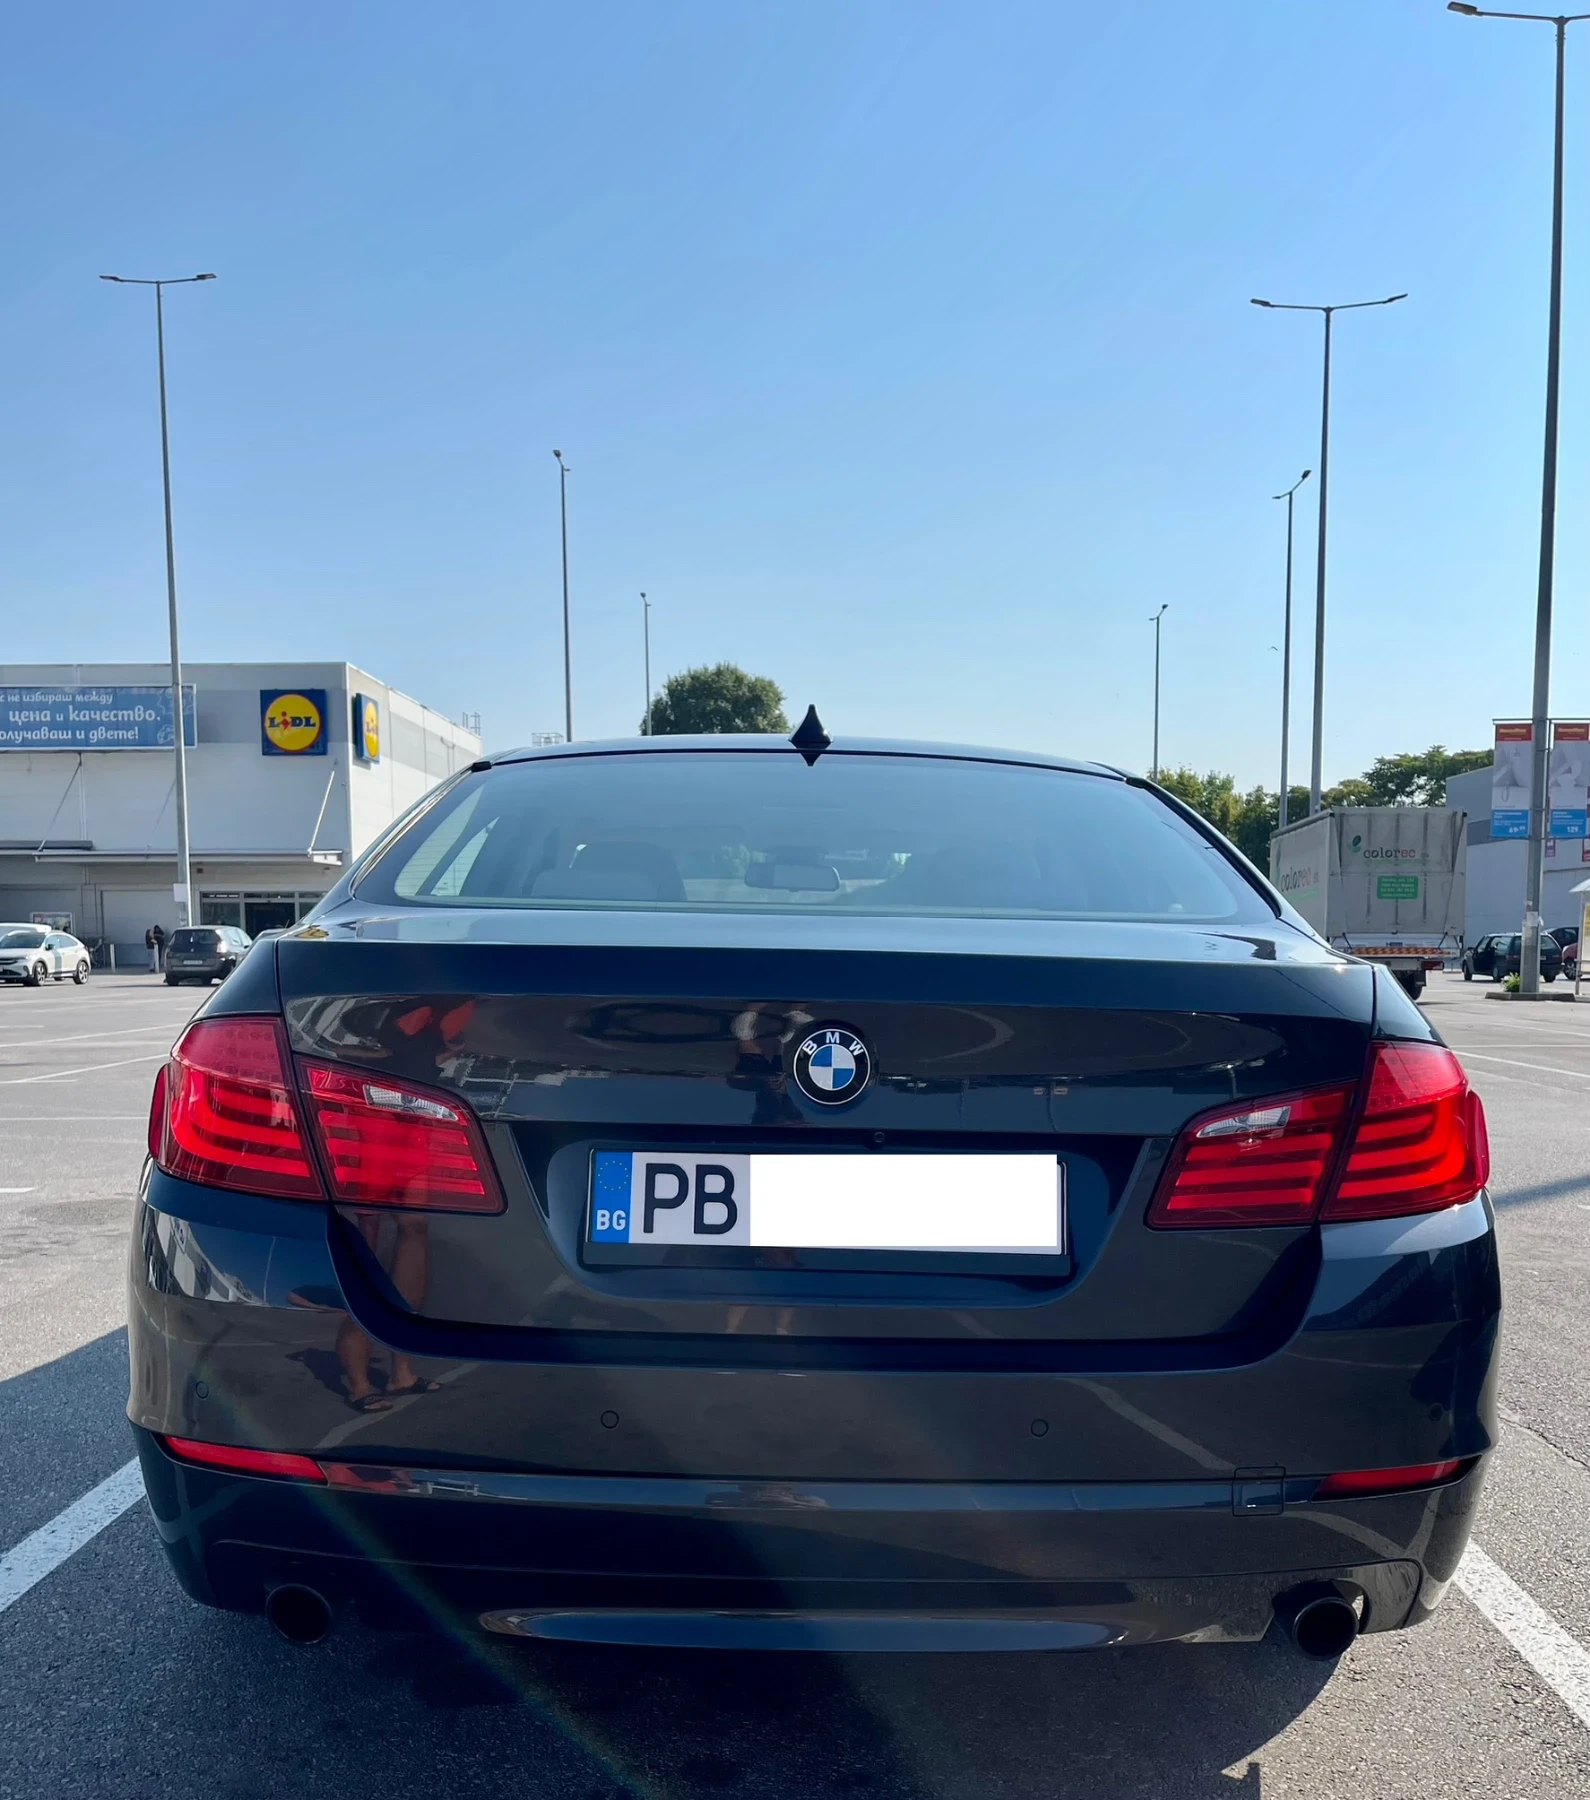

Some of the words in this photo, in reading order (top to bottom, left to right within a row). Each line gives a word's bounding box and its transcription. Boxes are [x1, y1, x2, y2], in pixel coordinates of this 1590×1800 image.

[7, 694, 20, 702] не
[22, 692, 72, 705] избираш
[75, 691, 113, 705] между
[9, 710, 51, 725] цена
[56, 713, 64, 721] и
[68, 705, 161, 722] качество.
[76, 730, 85, 739] и
[89, 726, 139, 743] двете!
[1363, 846, 1416, 859] colorec
[802, 1032, 864, 1056] BMW
[642, 1163, 738, 1236] PB
[596, 1209, 627, 1231] BG
